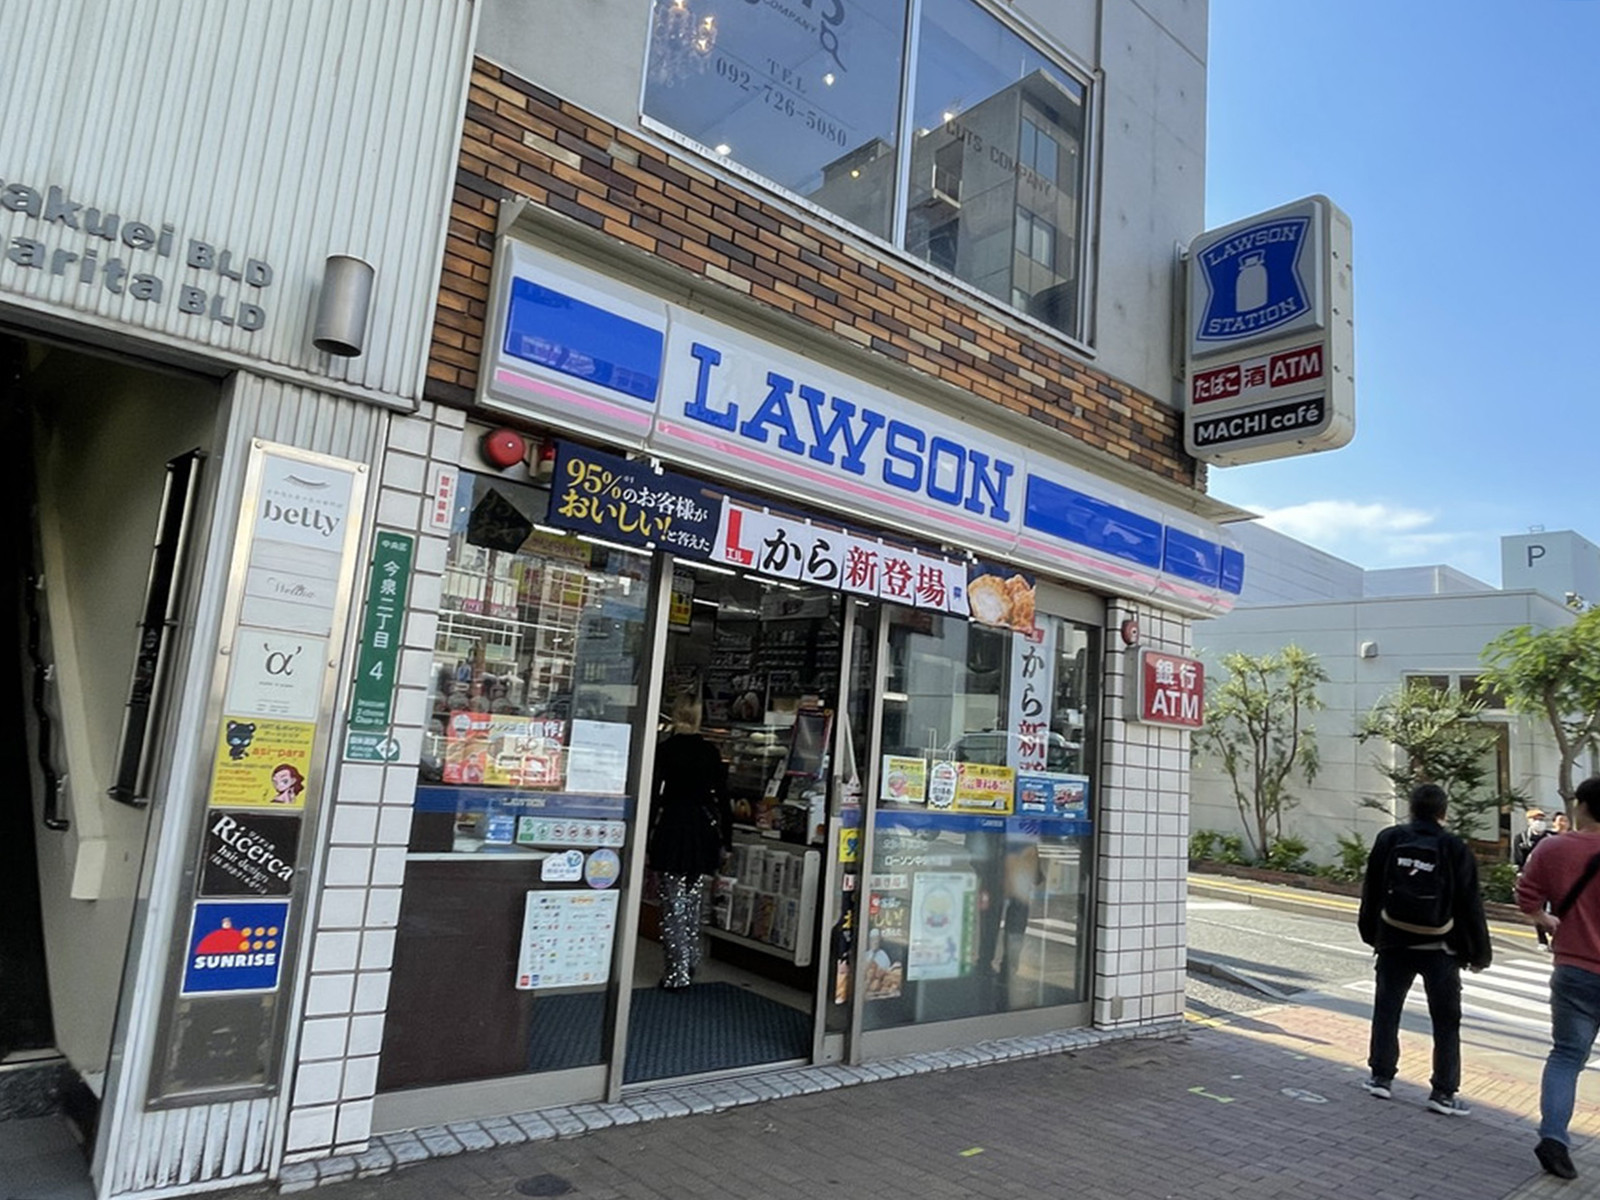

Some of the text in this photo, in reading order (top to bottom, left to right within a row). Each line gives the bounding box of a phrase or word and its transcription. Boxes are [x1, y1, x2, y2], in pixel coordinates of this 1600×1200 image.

[767, 57, 807, 94] TEL
[716, 57, 848, 148] 092-726-5080
[0, 179, 273, 287] akuei BLD
[1208, 225, 1298, 266] LAWSON
[179, 283, 265, 331] BLD
[1208, 297, 1297, 333] STATION
[1195, 371, 1239, 399] たばこ
[1271, 352, 1320, 383] ATM
[684, 342, 1013, 522] LAWSON
[1198, 404, 1319, 443] MACHI café
[263, 499, 341, 537] betty
[1527, 545, 1546, 568] P
[369, 660, 384, 681] 4
[1156, 659, 1197, 690] 銀行
[1151, 688, 1199, 720] ATM
[212, 816, 294, 881] Ricerca
[194, 953, 276, 969] SUNRISE
